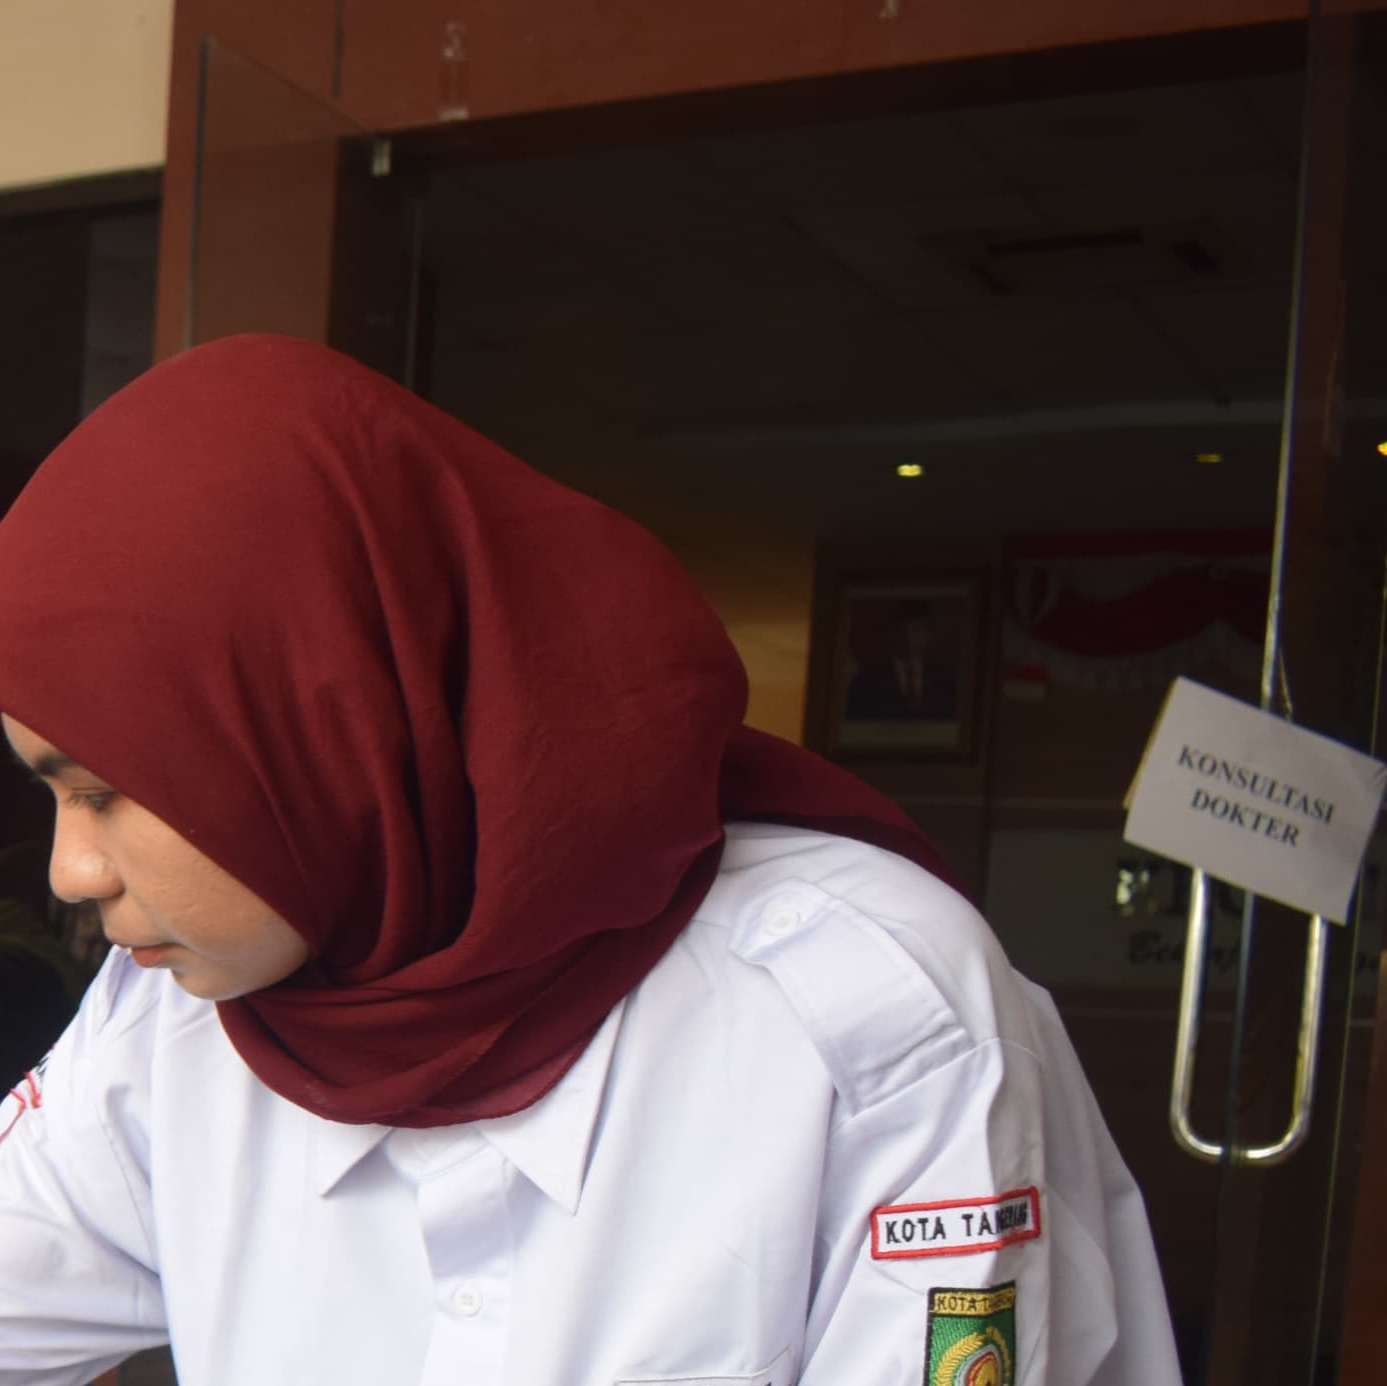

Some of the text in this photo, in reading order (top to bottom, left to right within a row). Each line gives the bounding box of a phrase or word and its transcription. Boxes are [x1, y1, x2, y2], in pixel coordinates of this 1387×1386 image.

[1178, 745, 1336, 823] KONSULTASI
[1190, 788, 1300, 848] DOKTER
[885, 1216, 946, 1244] KOTA
